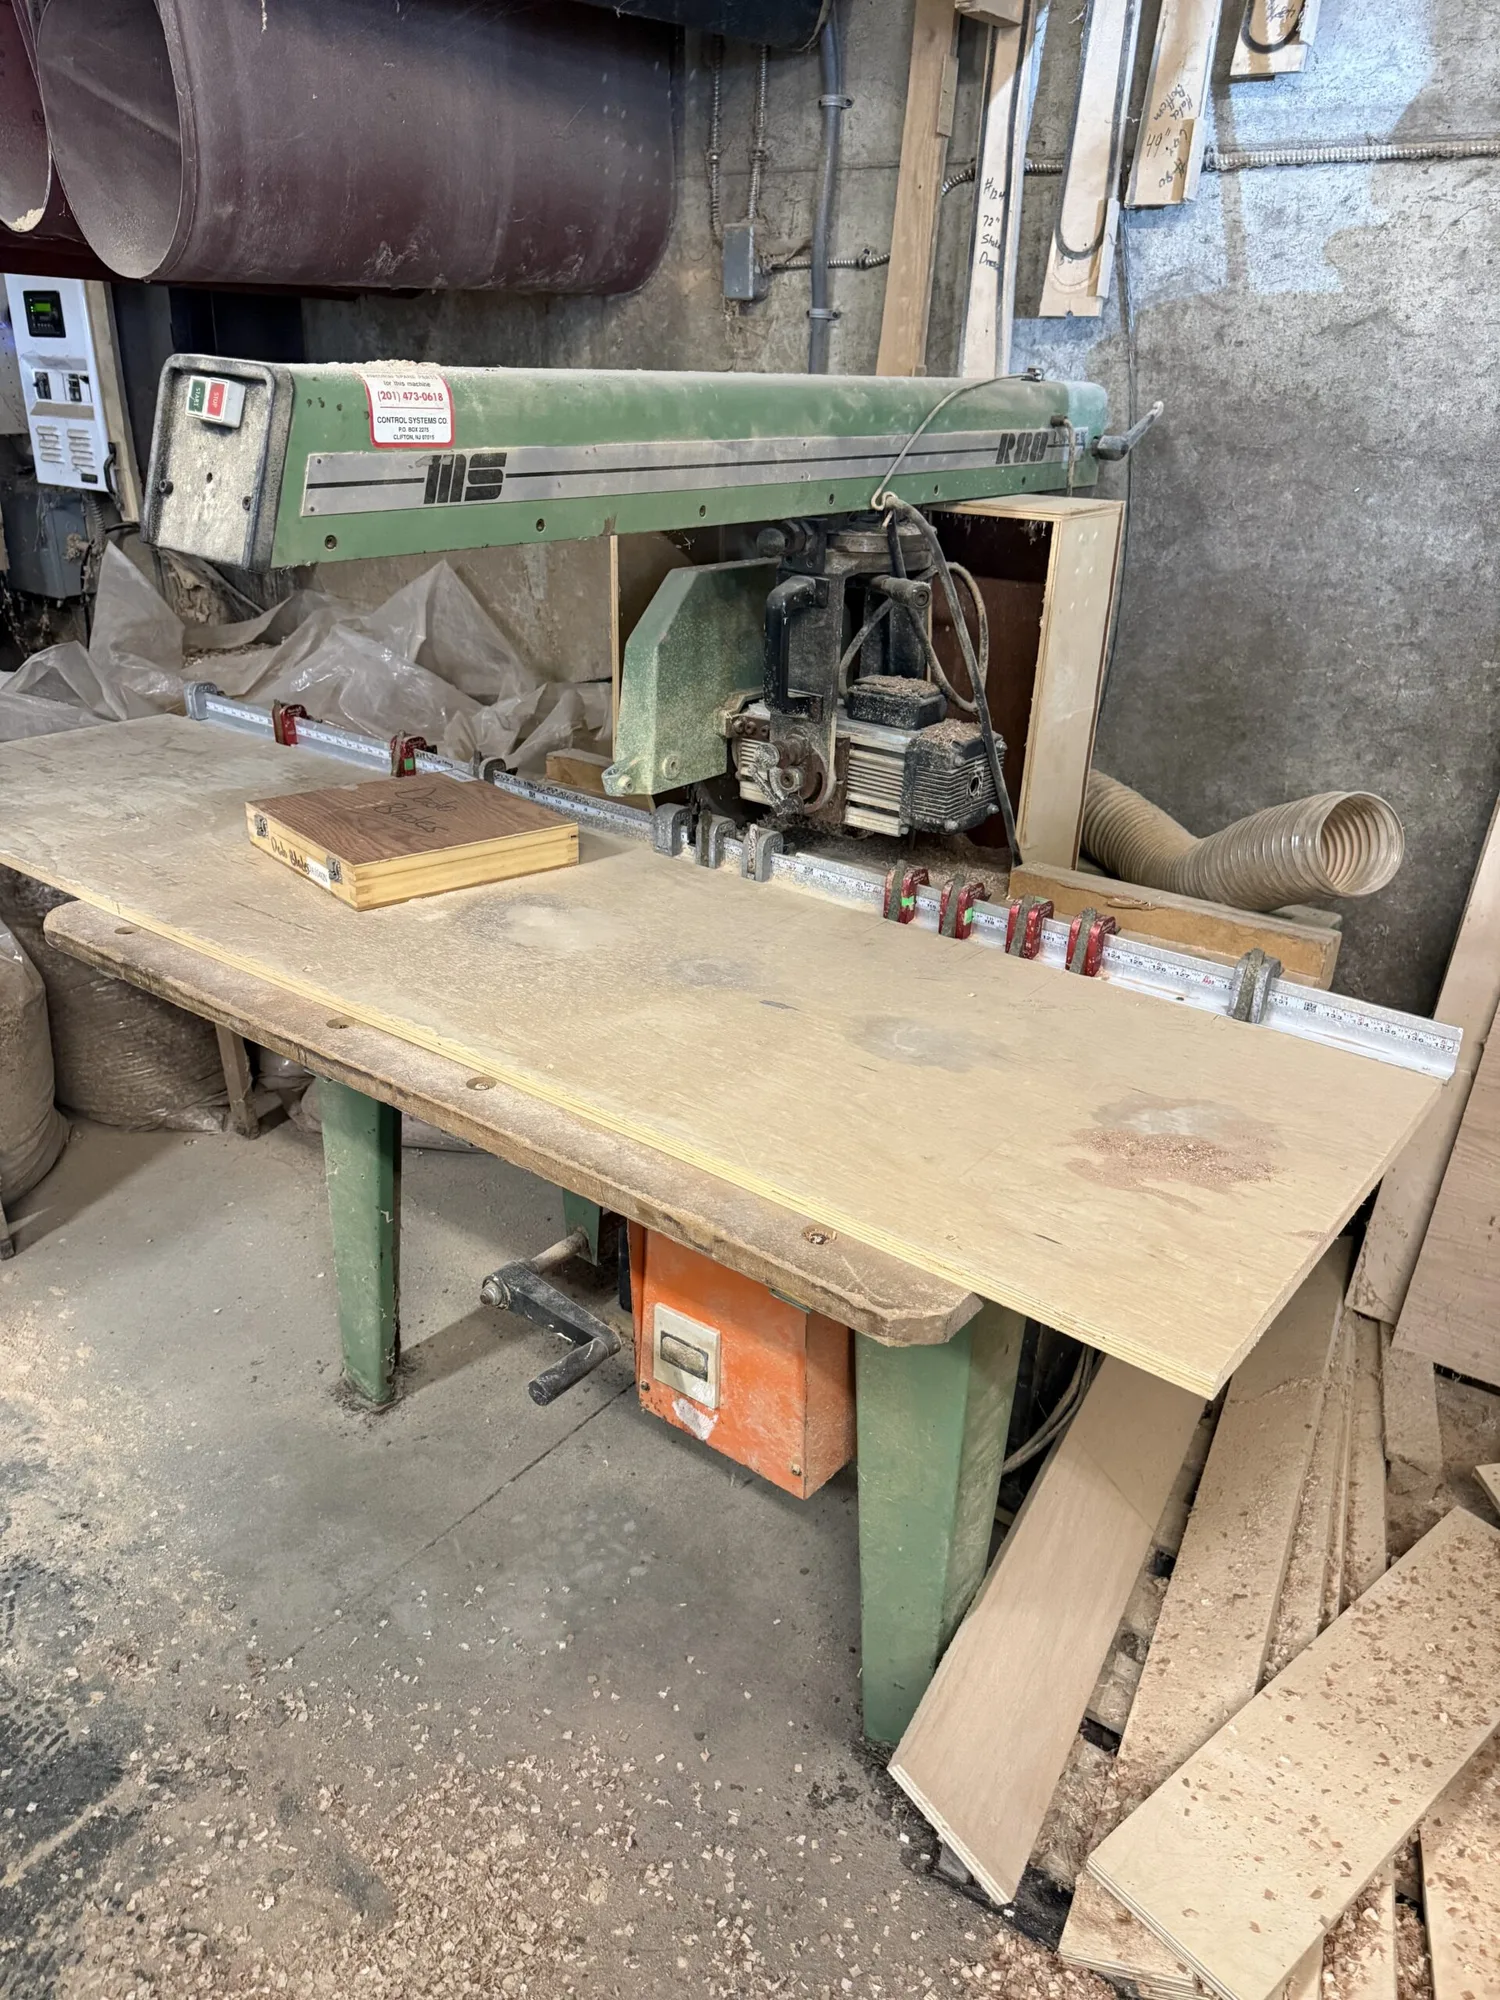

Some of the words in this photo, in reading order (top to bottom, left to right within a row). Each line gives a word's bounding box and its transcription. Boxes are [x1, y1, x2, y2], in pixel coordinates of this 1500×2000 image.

[378, 391, 401, 402] (201)
[403, 392, 444, 402] 473-0618
[377, 416, 407, 424] CONTROL
[408, 417, 437, 425] SYSTEMS
[438, 417, 448, 425] CO.
[373, 803, 449, 832] Blades
[1406, 1034, 1424, 1043] 136
[1434, 1041, 1453, 1051] 137
